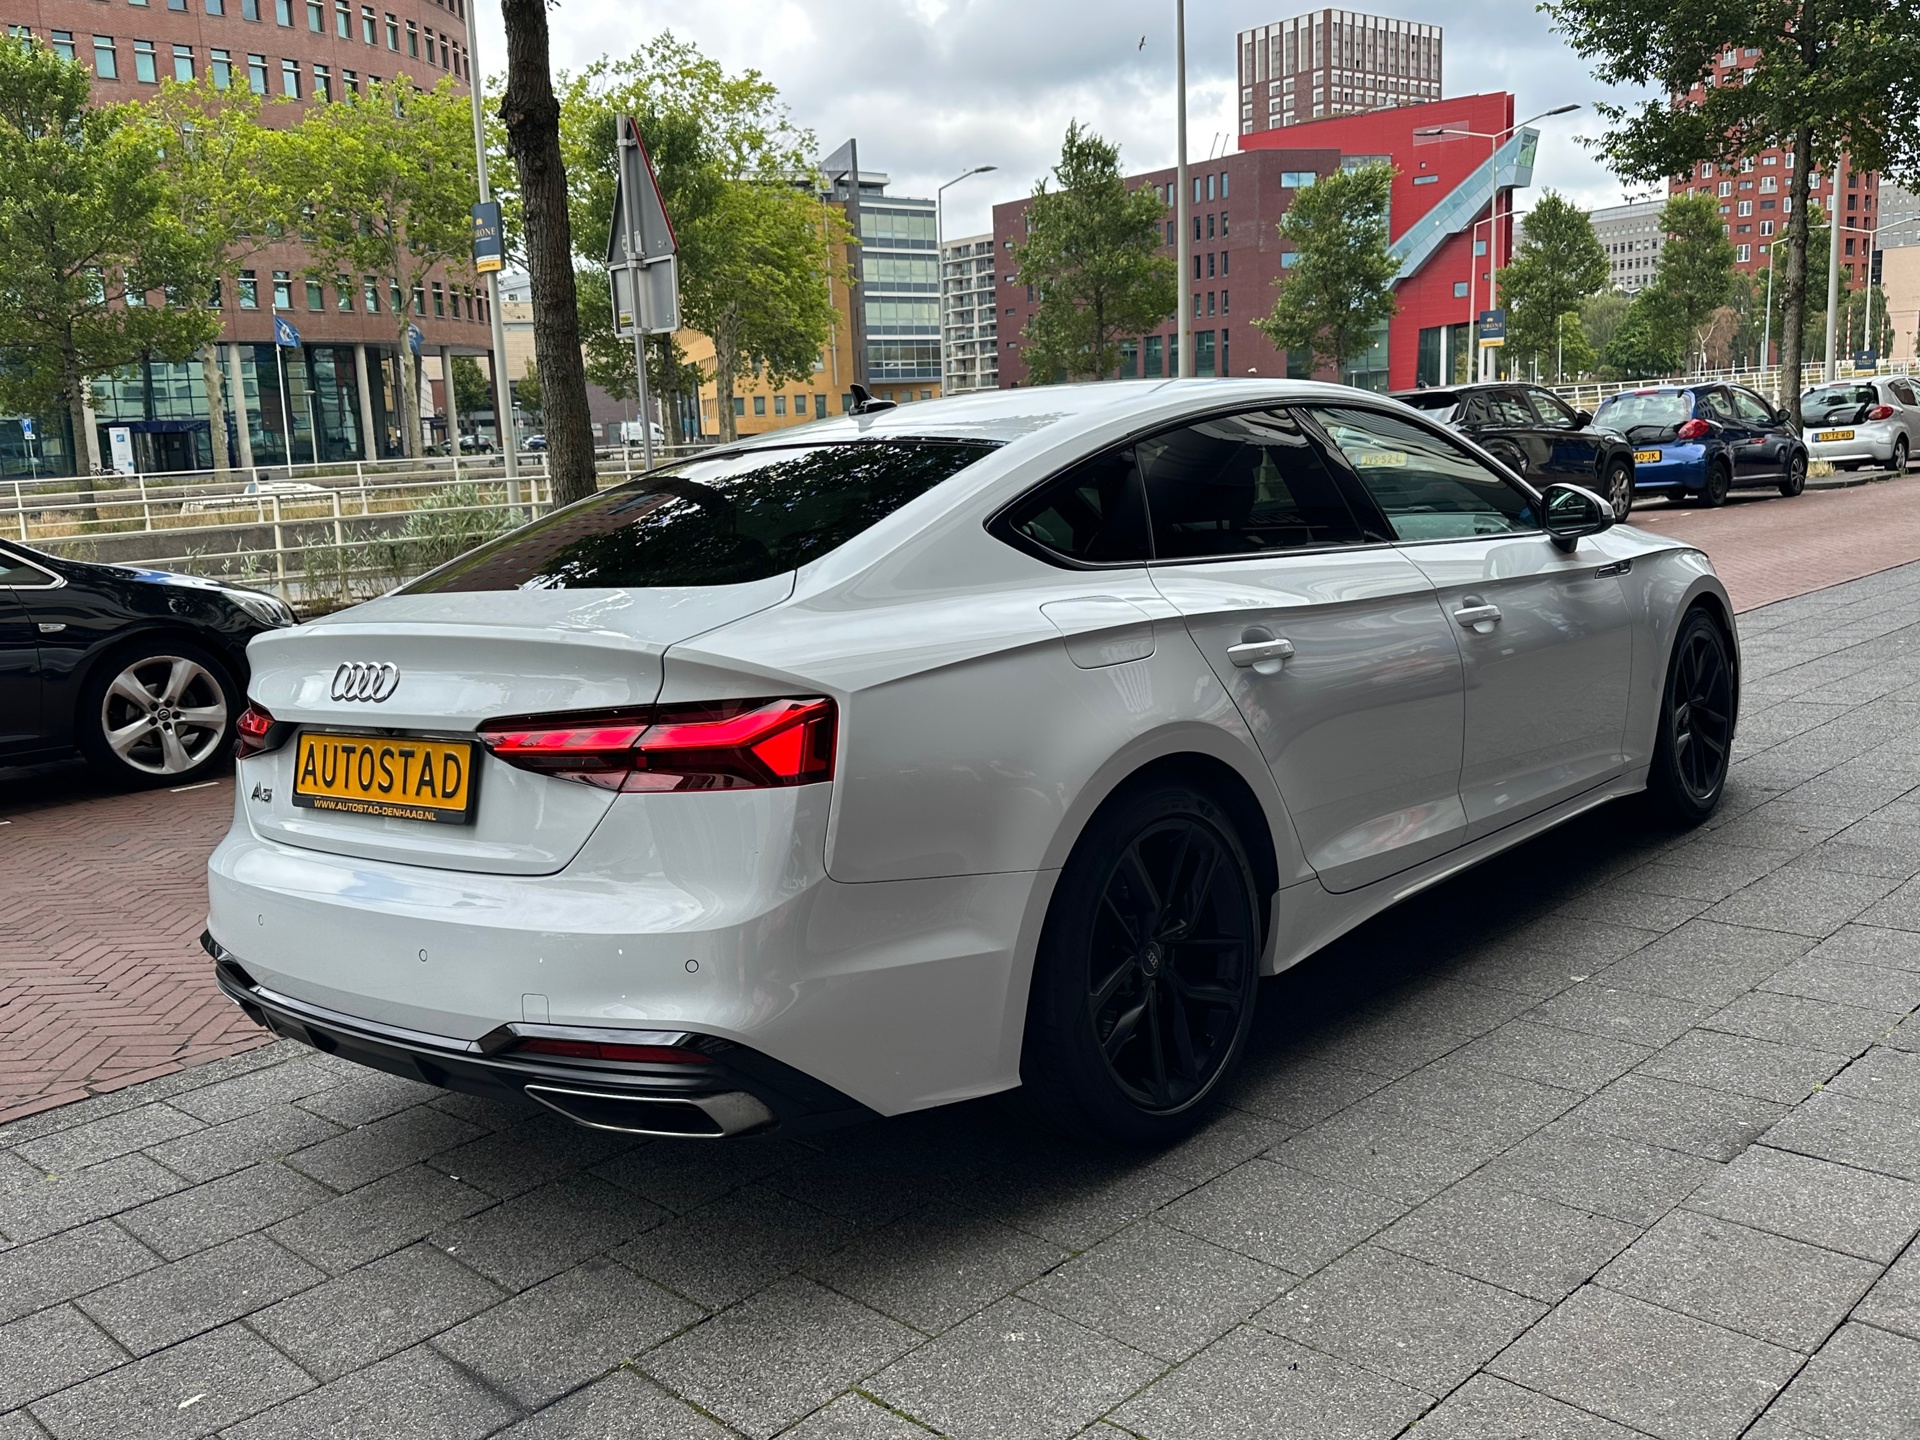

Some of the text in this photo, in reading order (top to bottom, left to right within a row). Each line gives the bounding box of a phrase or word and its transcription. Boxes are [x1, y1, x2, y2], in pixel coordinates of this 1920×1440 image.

[1634, 452, 1657, 461] 40-JK
[301, 742, 462, 799] AUTOSTAD
[251, 781, 272, 803] A5
[314, 800, 436, 820] WWW.AUTOSTAD-DENHAAG.NL
